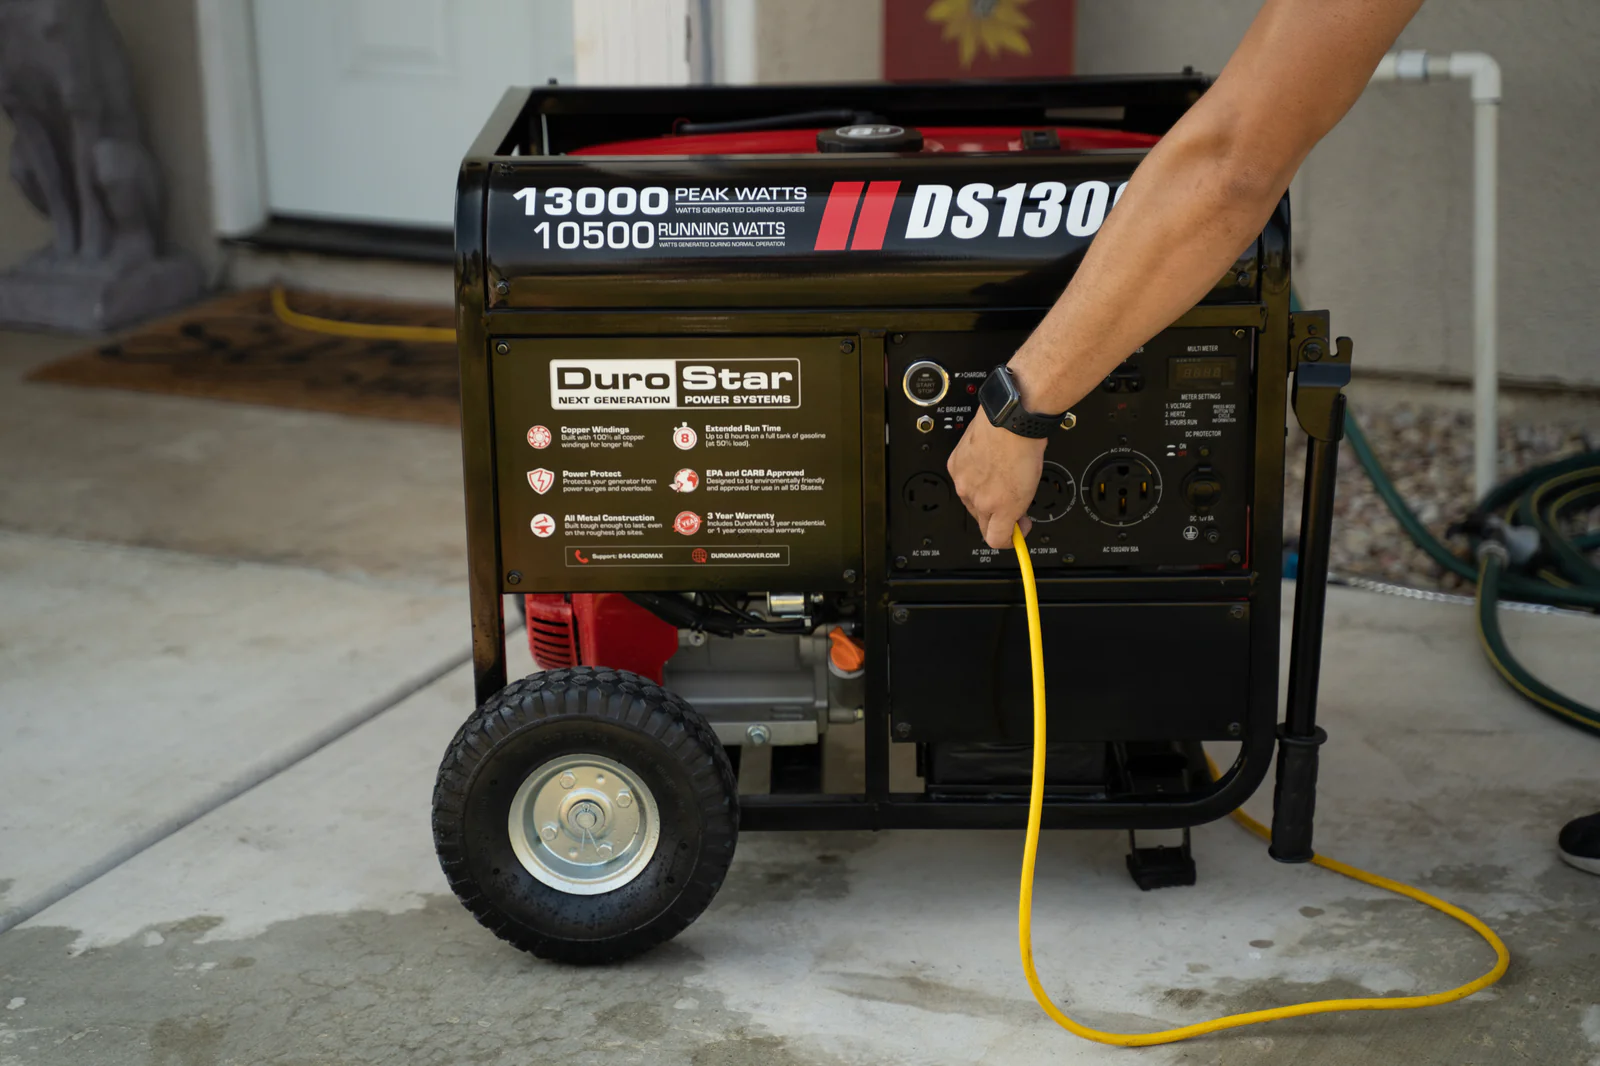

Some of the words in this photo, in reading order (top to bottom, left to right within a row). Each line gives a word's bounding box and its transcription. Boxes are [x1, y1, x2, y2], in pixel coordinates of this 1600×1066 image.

[675, 188, 730, 201] PEAK
[735, 186, 807, 200] WATTS
[513, 186, 668, 216] 13000
[904, 180, 1130, 239] DS130
[658, 222, 729, 236] RUNNING
[732, 222, 785, 235] WATTS
[534, 222, 655, 250] 10500
[556, 367, 670, 390] Duro
[682, 366, 793, 390] Star
[594, 396, 670, 404] GENERATION
[684, 396, 729, 404] POWER
[733, 395, 791, 404] SYSTEMS
[561, 426, 590, 434] Copper
[592, 426, 629, 434] Windings
[762, 424, 781, 432] Time
[681, 433, 689, 443] 8
[800, 432, 826, 440] gasoline
[705, 440, 715, 448] (at
[733, 440, 750, 448] load).
[562, 470, 589, 478] Power
[590, 470, 622, 478] Protect
[706, 469, 723, 477] EPA
[725, 469, 739, 477] and
[766, 469, 804, 478] Approved
[564, 514, 575, 522] All
[577, 514, 600, 522] Metal
[707, 512, 713, 520] 3
[715, 512, 734, 520] Year
[735, 512, 775, 520] Warranty
